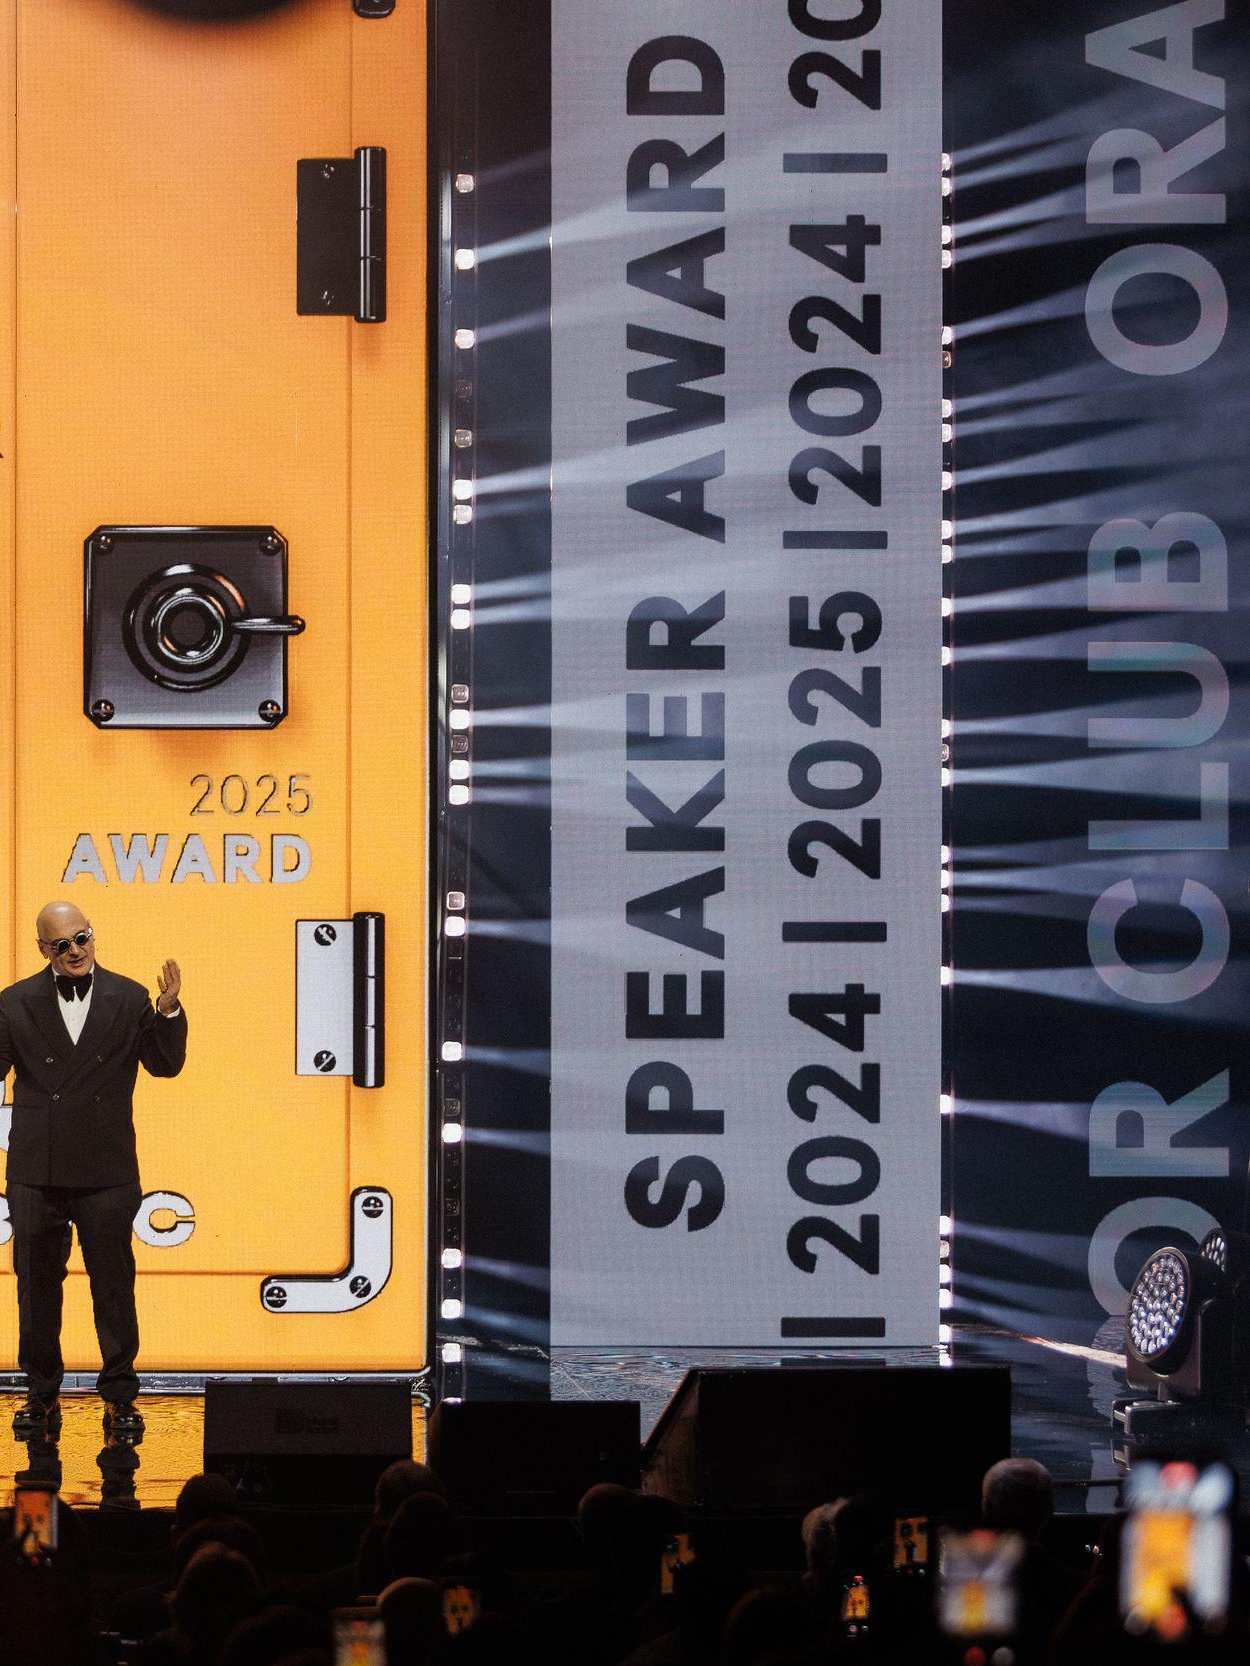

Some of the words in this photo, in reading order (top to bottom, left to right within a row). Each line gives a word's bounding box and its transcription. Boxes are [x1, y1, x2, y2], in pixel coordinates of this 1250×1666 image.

[626, 35, 726, 544] AWARD
[1085, 0, 1228, 376] ORA
[788, 214, 882, 507] 2024
[62, 833, 312, 885] AWARD
[190, 774, 314, 818] 2025
[788, 590, 882, 880] 2025
[1086, 511, 1230, 1003] CLUB
[625, 590, 726, 1232] SPEAKER
[787, 982, 881, 1275] 2024
